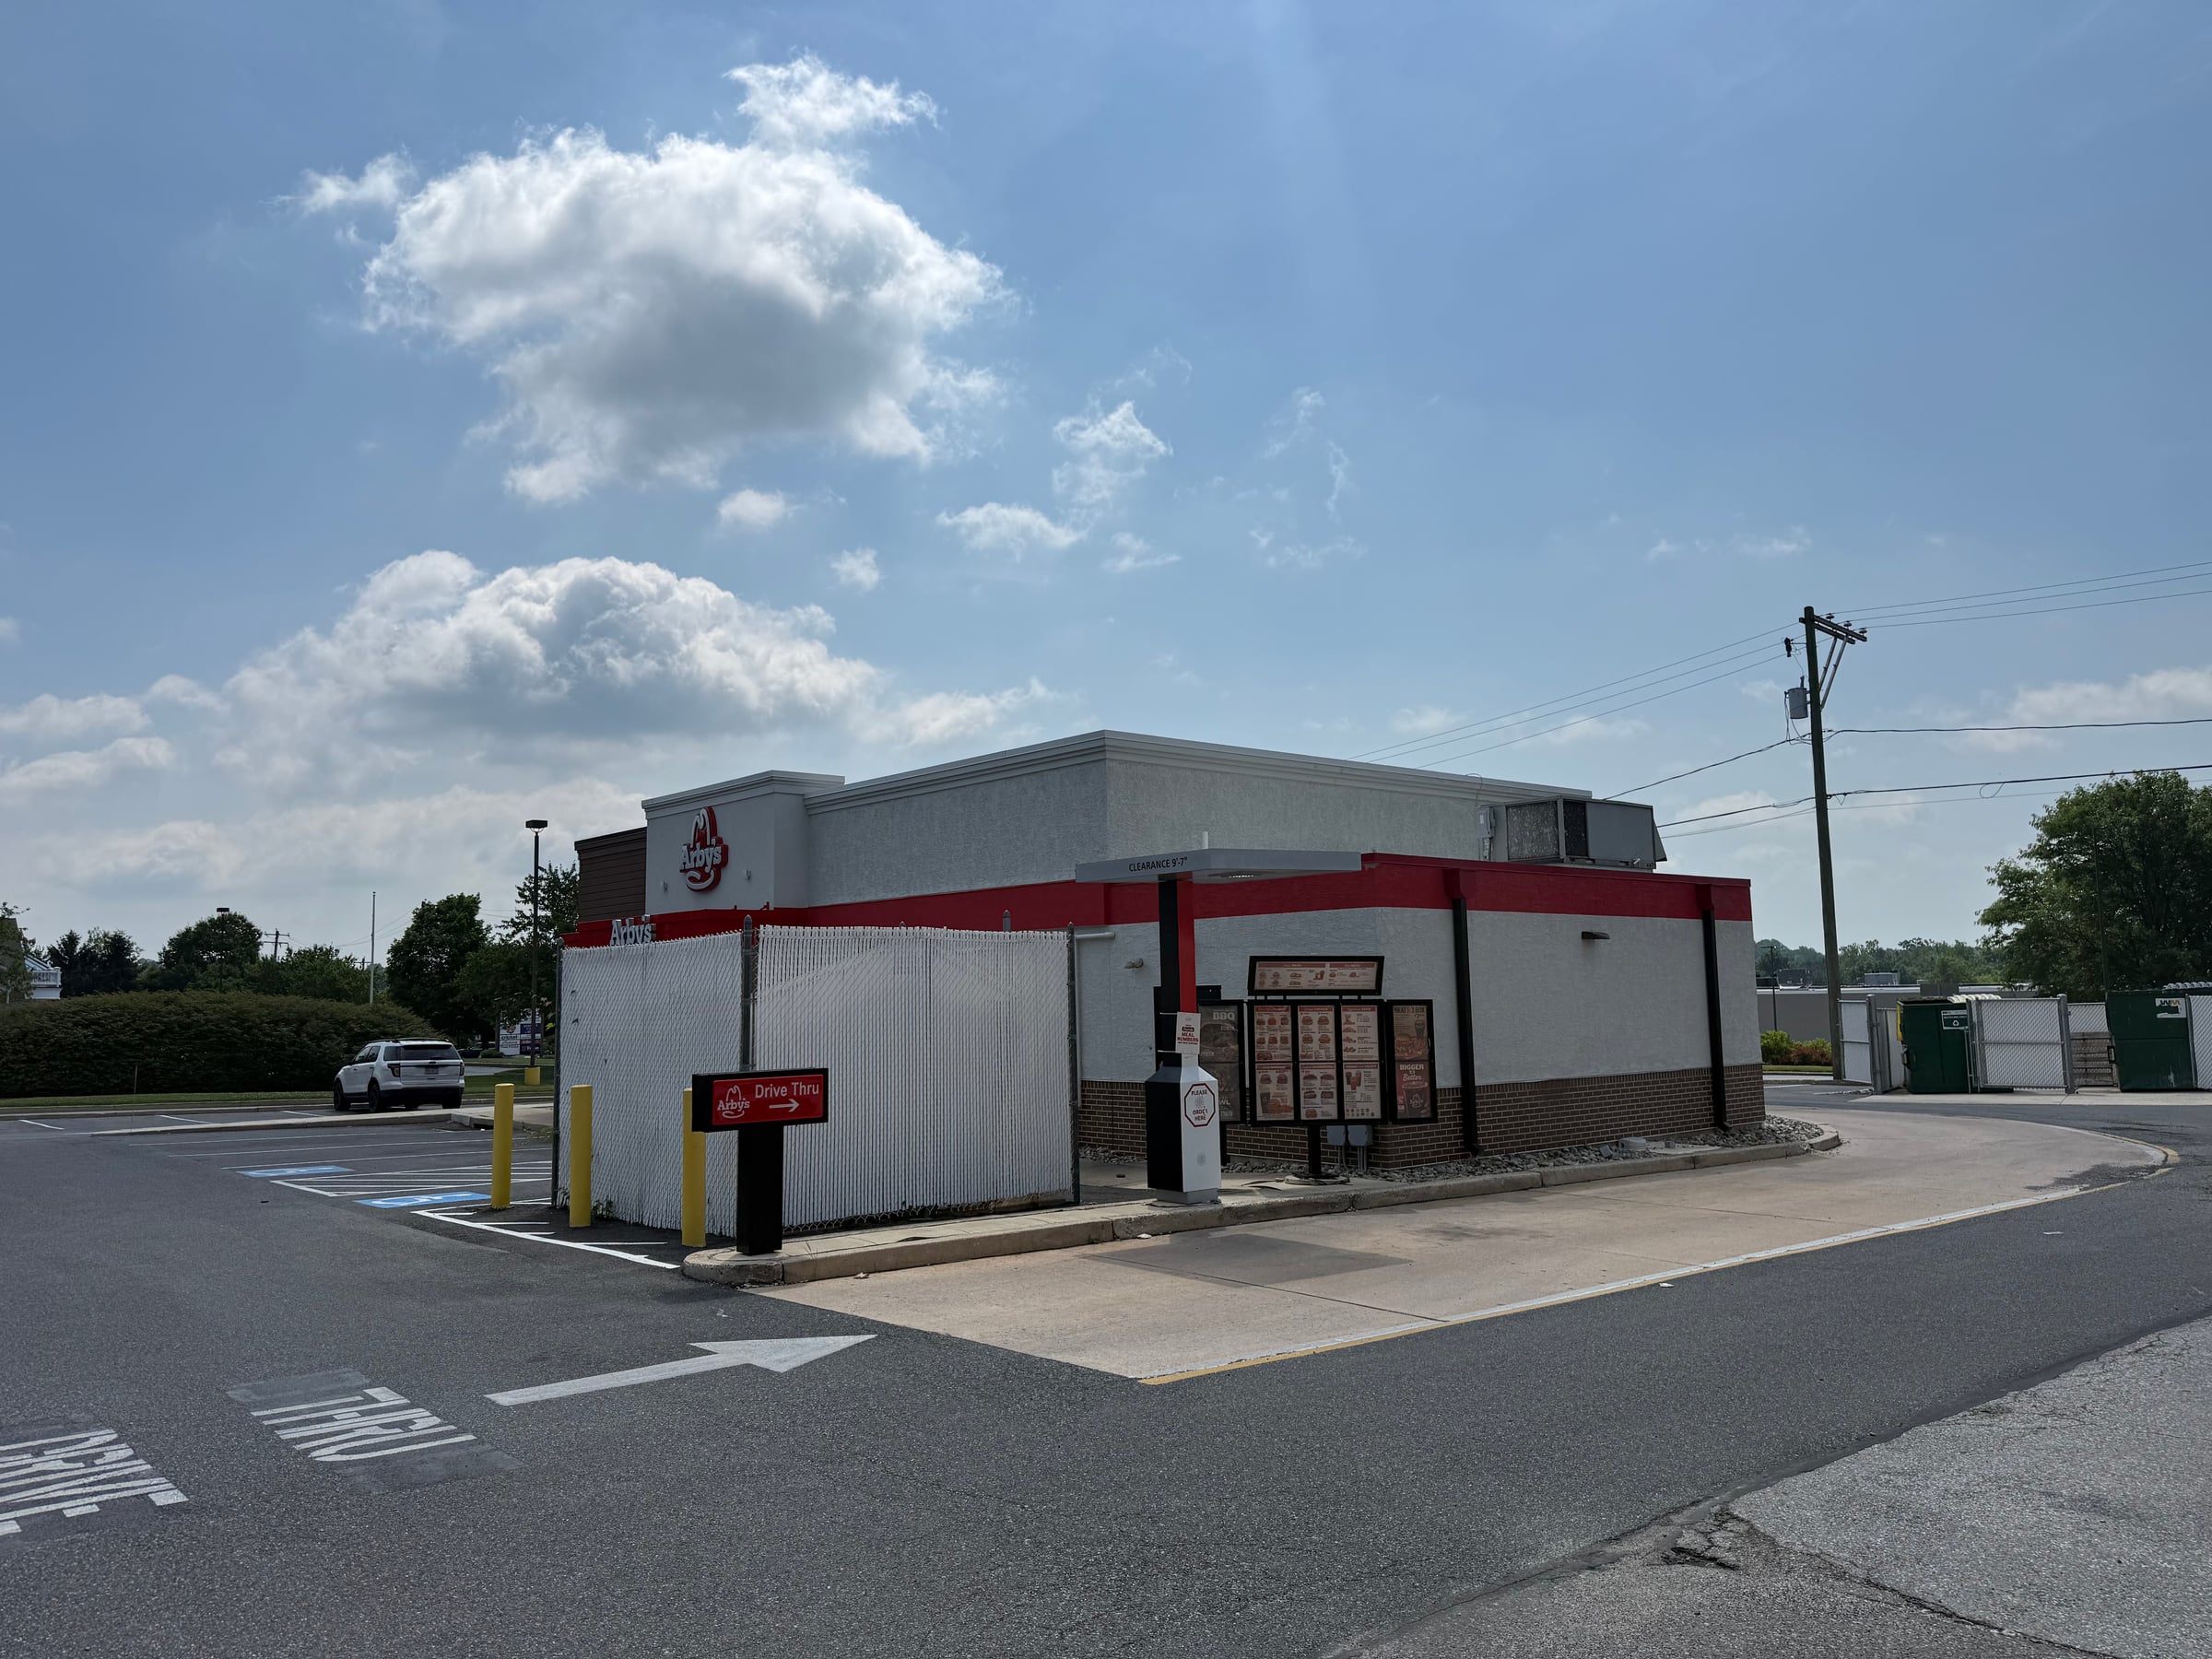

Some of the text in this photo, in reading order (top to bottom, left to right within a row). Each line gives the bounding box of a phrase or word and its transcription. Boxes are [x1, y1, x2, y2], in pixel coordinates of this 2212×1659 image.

[680, 838, 722, 874] Arby's
[1128, 859, 1171, 872] CLEARANCE
[610, 914, 653, 946] Arby's
[1213, 1012, 1235, 1020] BBQ
[755, 1081, 819, 1100] Drive Thru
[717, 1098, 751, 1112] Arby's
[251, 1386, 477, 1463] THRU
